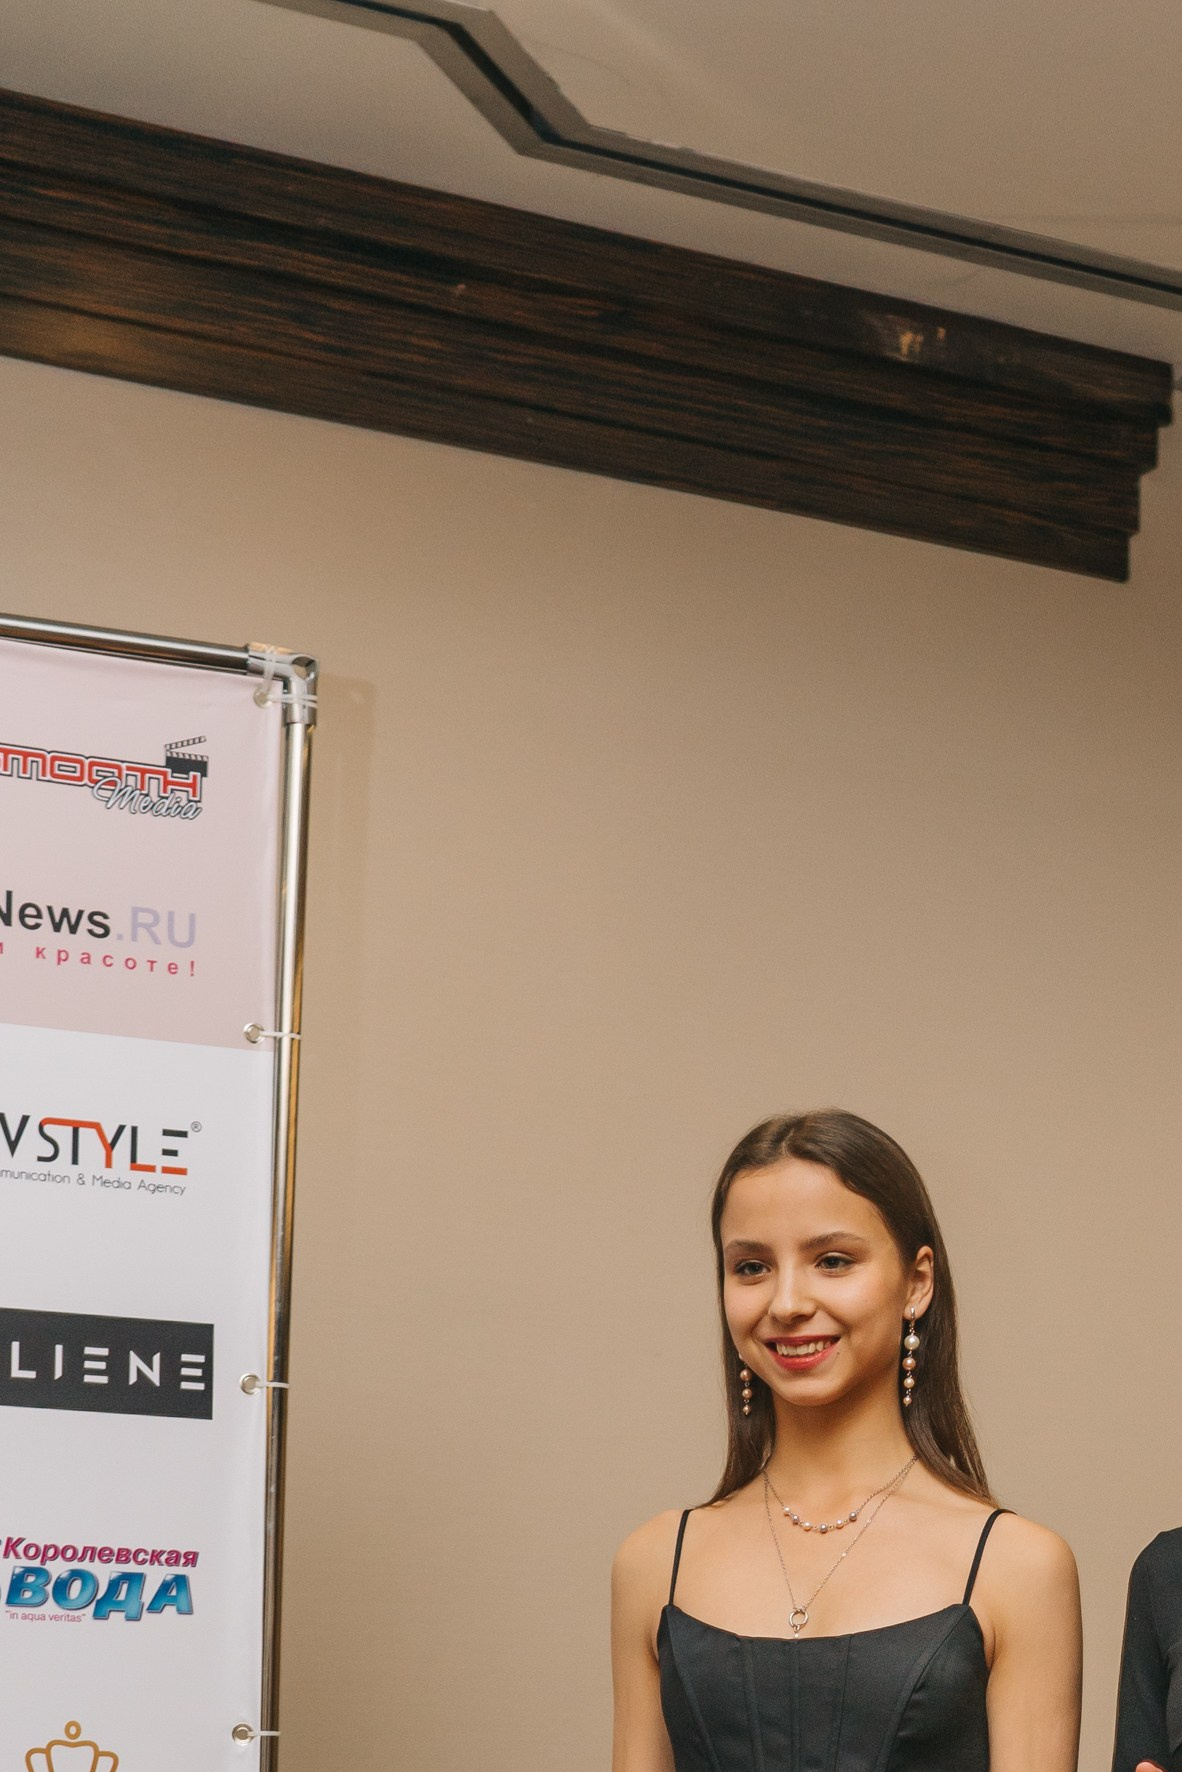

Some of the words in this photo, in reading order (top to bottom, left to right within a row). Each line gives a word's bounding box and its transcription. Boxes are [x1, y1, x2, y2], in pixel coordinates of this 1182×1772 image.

[91, 776, 203, 820] Media
[35, 946, 195, 977] красоте!
[76, 1173, 86, 1186] &
[91, 1174, 132, 1190] Media
[137, 1179, 186, 1196] Agency
[10, 1340, 206, 1390] LIENE
[3, 1536, 199, 1567] Королевская
[5, 1566, 194, 1621] ВОДА
[21, 1612, 46, 1623] aqua
